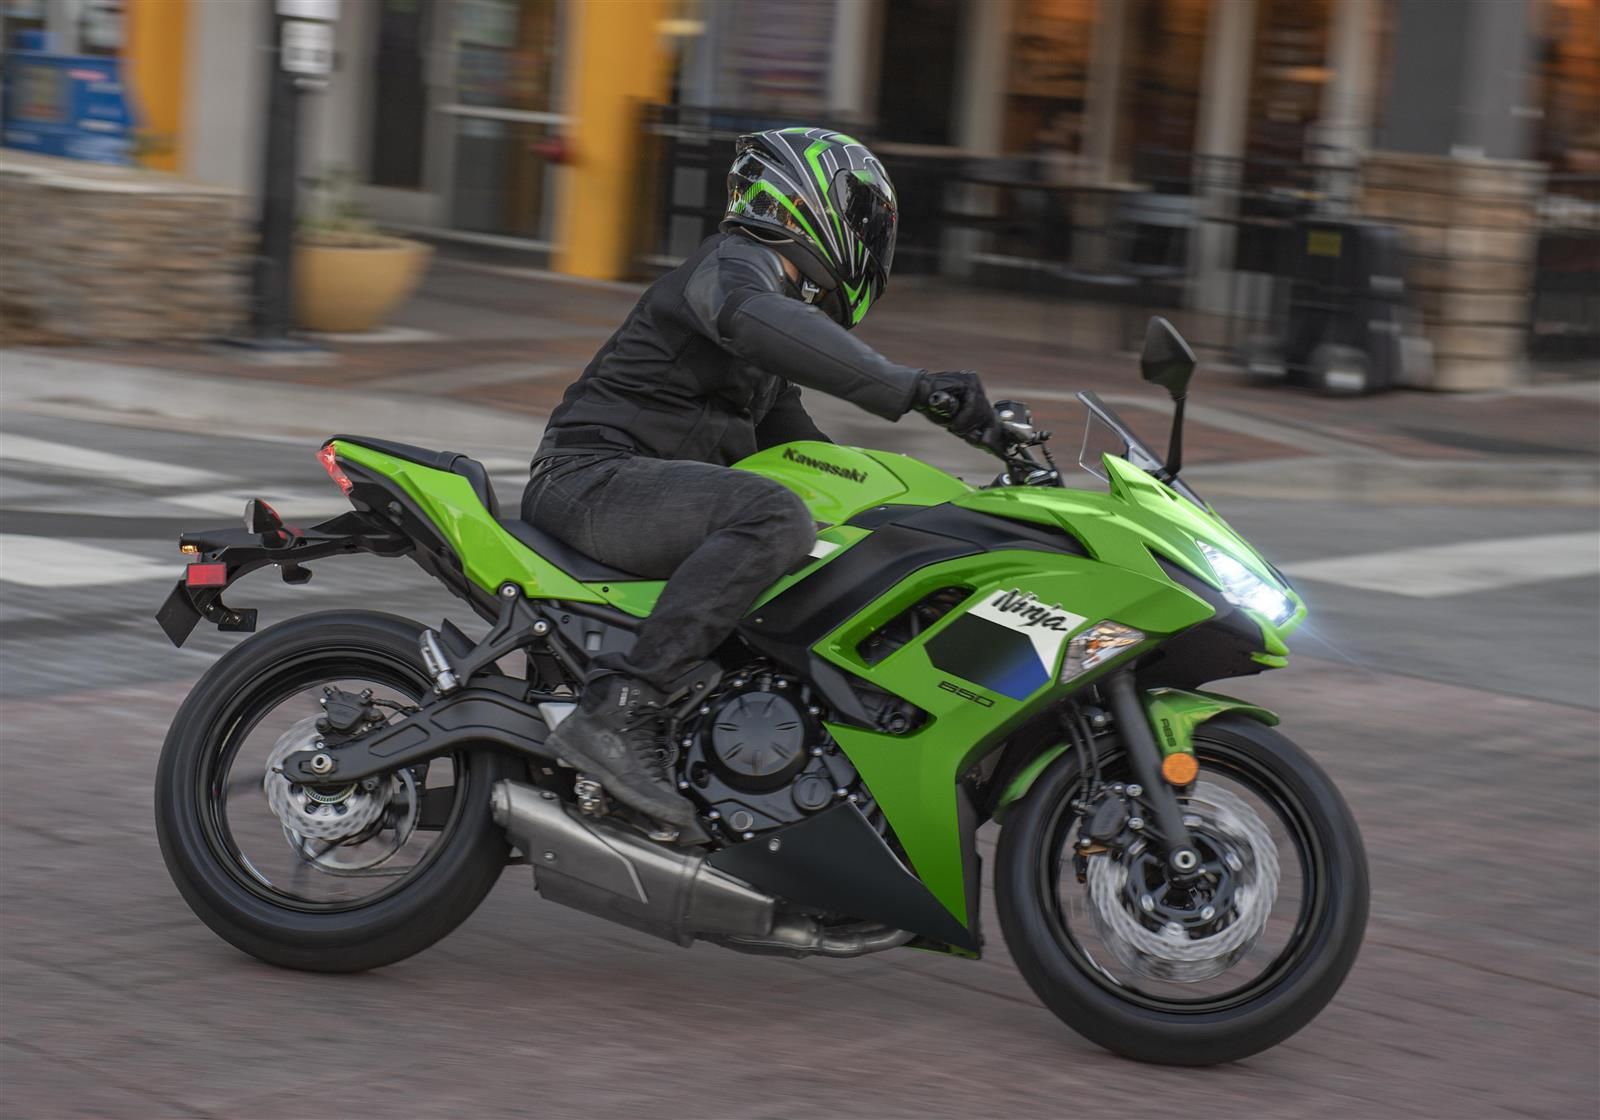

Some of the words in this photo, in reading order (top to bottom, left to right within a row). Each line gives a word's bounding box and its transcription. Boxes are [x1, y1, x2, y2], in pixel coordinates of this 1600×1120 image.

[782, 447, 869, 484] Kawasaki
[991, 588, 1068, 632] Ninja
[938, 680, 996, 708] 650
[1160, 719, 1177, 748] ABS
